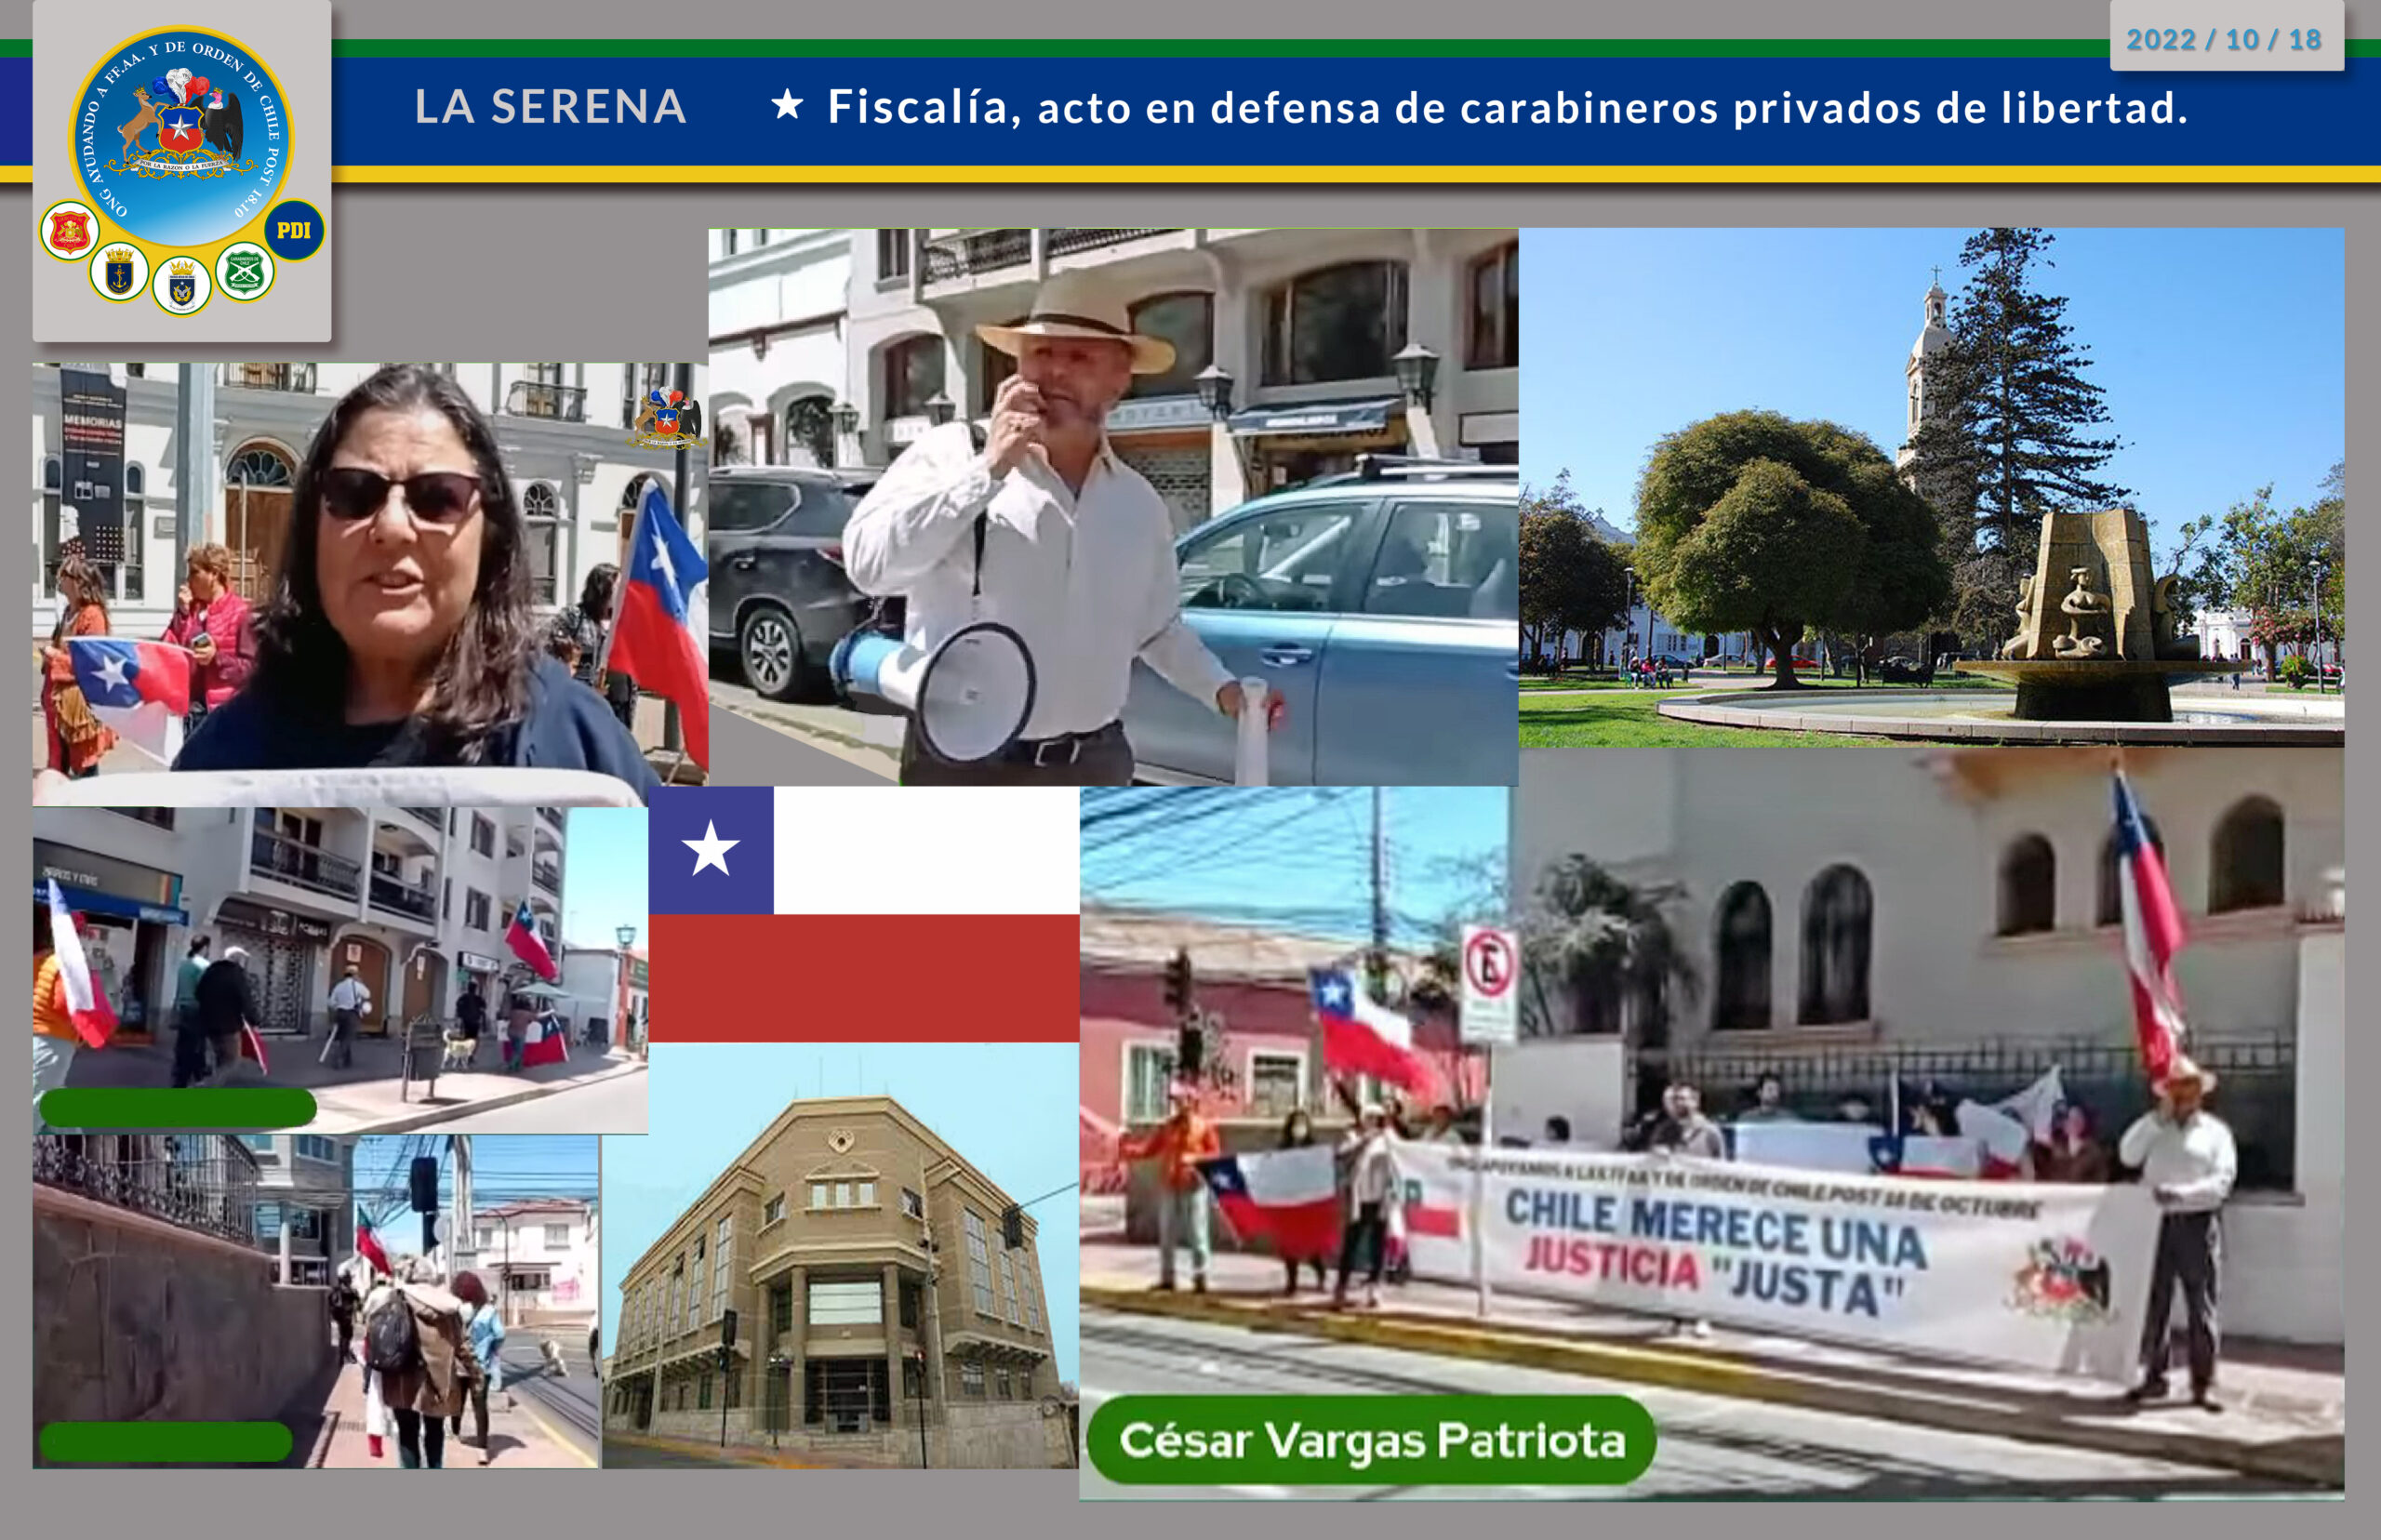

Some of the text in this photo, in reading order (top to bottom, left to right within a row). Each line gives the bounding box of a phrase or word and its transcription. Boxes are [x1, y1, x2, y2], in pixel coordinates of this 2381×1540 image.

[64, 414, 123, 430] MEMORIAS
[1505, 1188, 1929, 1271] CHILE MERECE UNA
[1772, 1180, 1828, 1202] CHILE
[1828, 1184, 1885, 1206] POST
[1909, 1192, 1938, 1212] DE
[1938, 1194, 2044, 1220] OCTUBRE
[1524, 1236, 1904, 1318] JUSTICIA "JUSTA"
